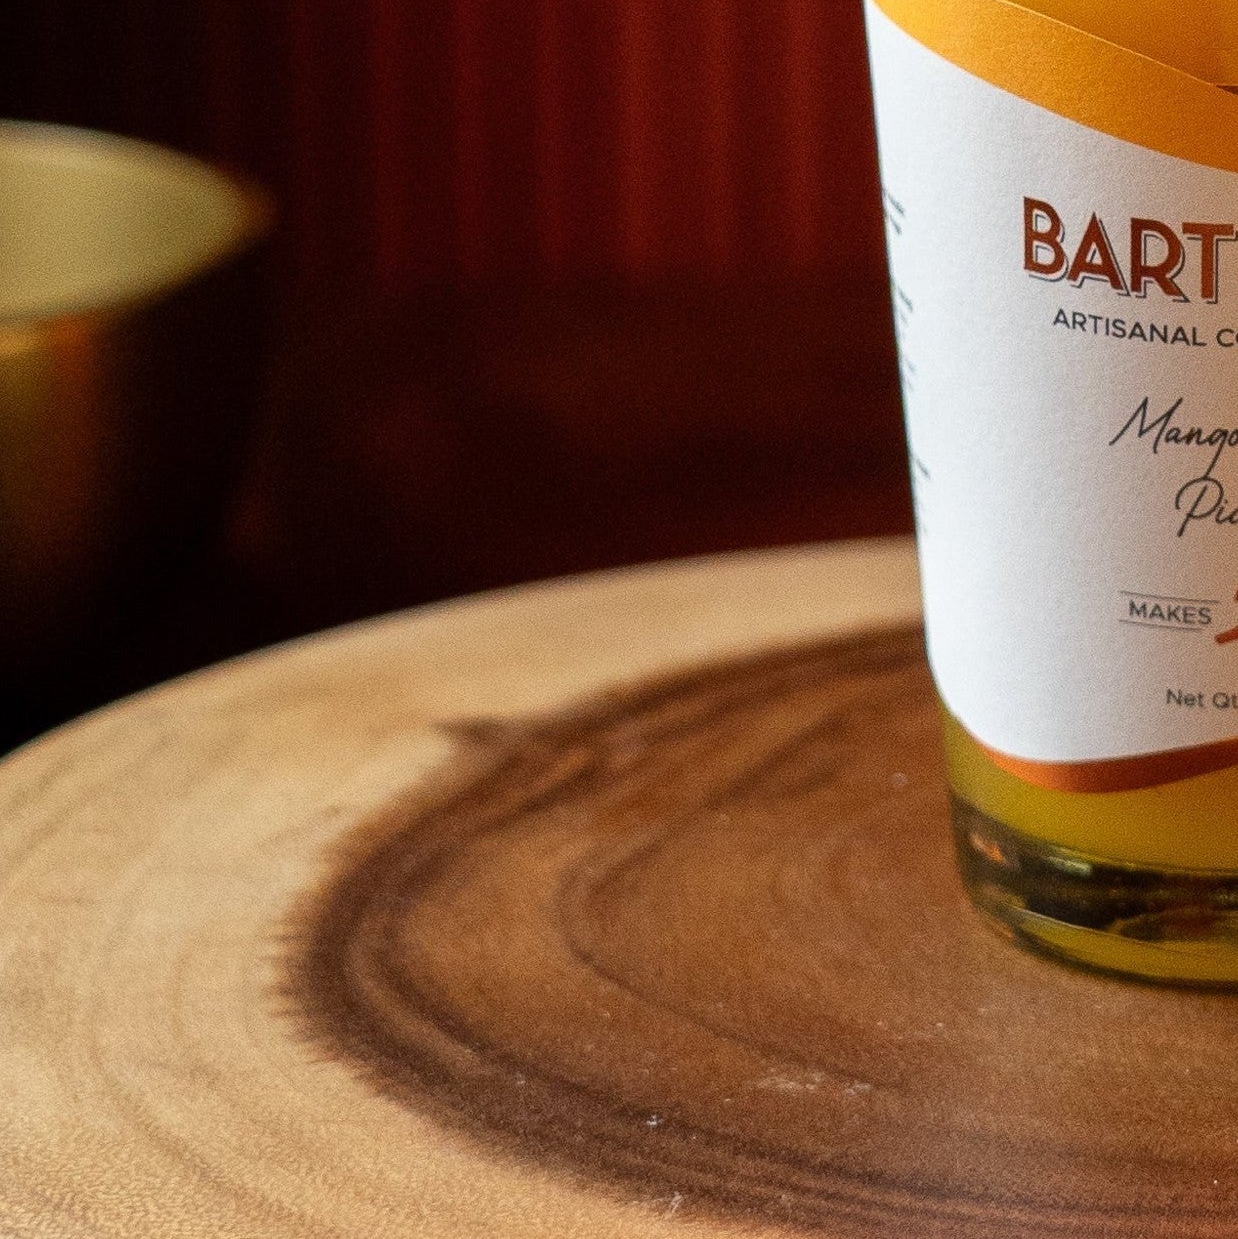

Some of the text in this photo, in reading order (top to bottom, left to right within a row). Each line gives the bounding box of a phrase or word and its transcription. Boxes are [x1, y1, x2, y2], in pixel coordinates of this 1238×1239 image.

[1053, 308, 1205, 347] ARTISANAL
[1128, 600, 1212, 625] MAKES
[1166, 688, 1205, 708] Net
